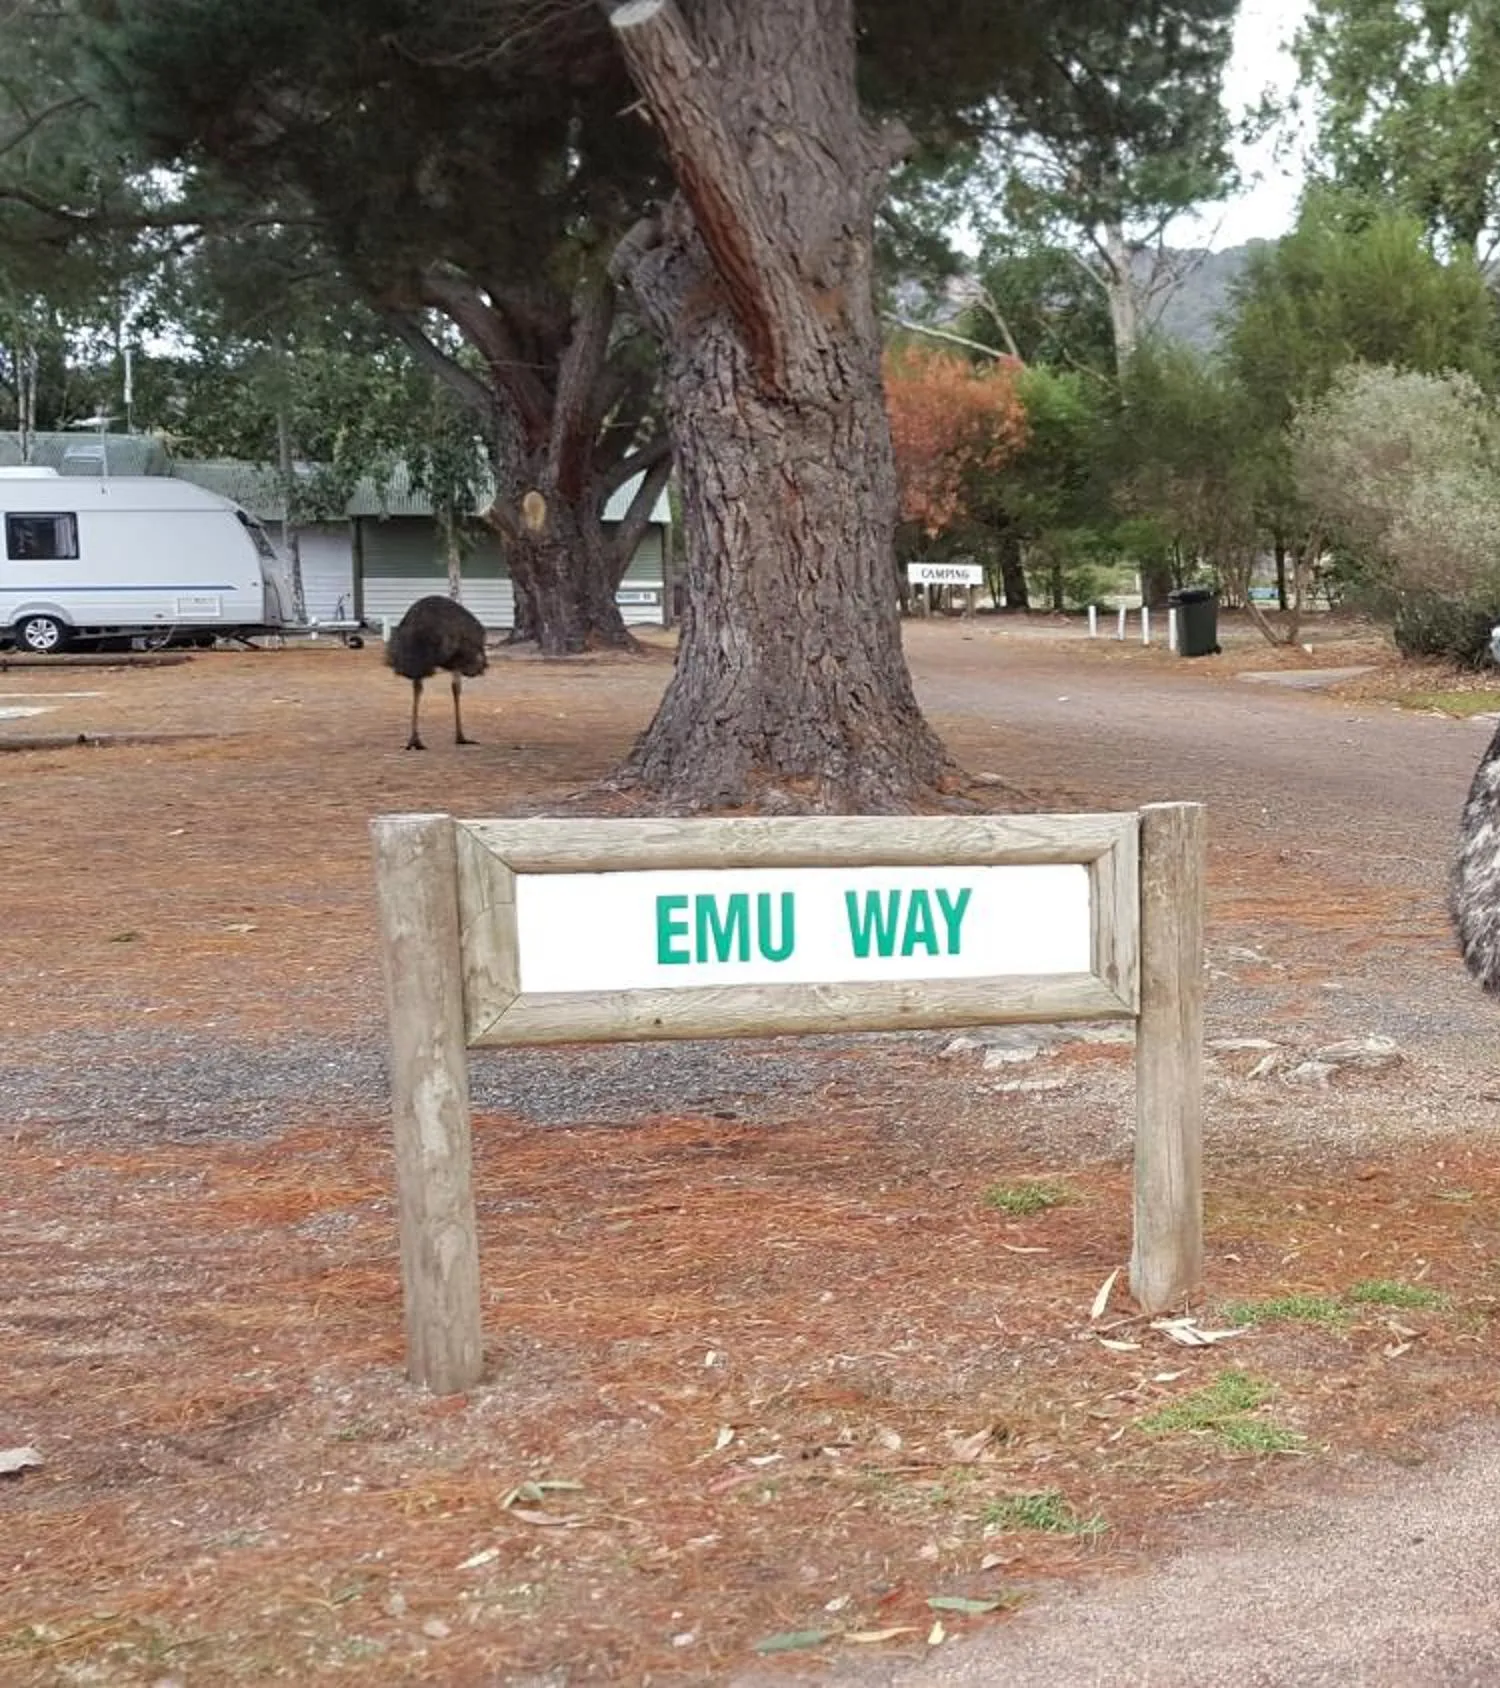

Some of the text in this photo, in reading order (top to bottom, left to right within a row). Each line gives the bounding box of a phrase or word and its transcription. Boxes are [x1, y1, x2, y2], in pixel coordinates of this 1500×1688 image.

[921, 567, 970, 580] CAMPING
[656, 888, 973, 965] EMU WAY
